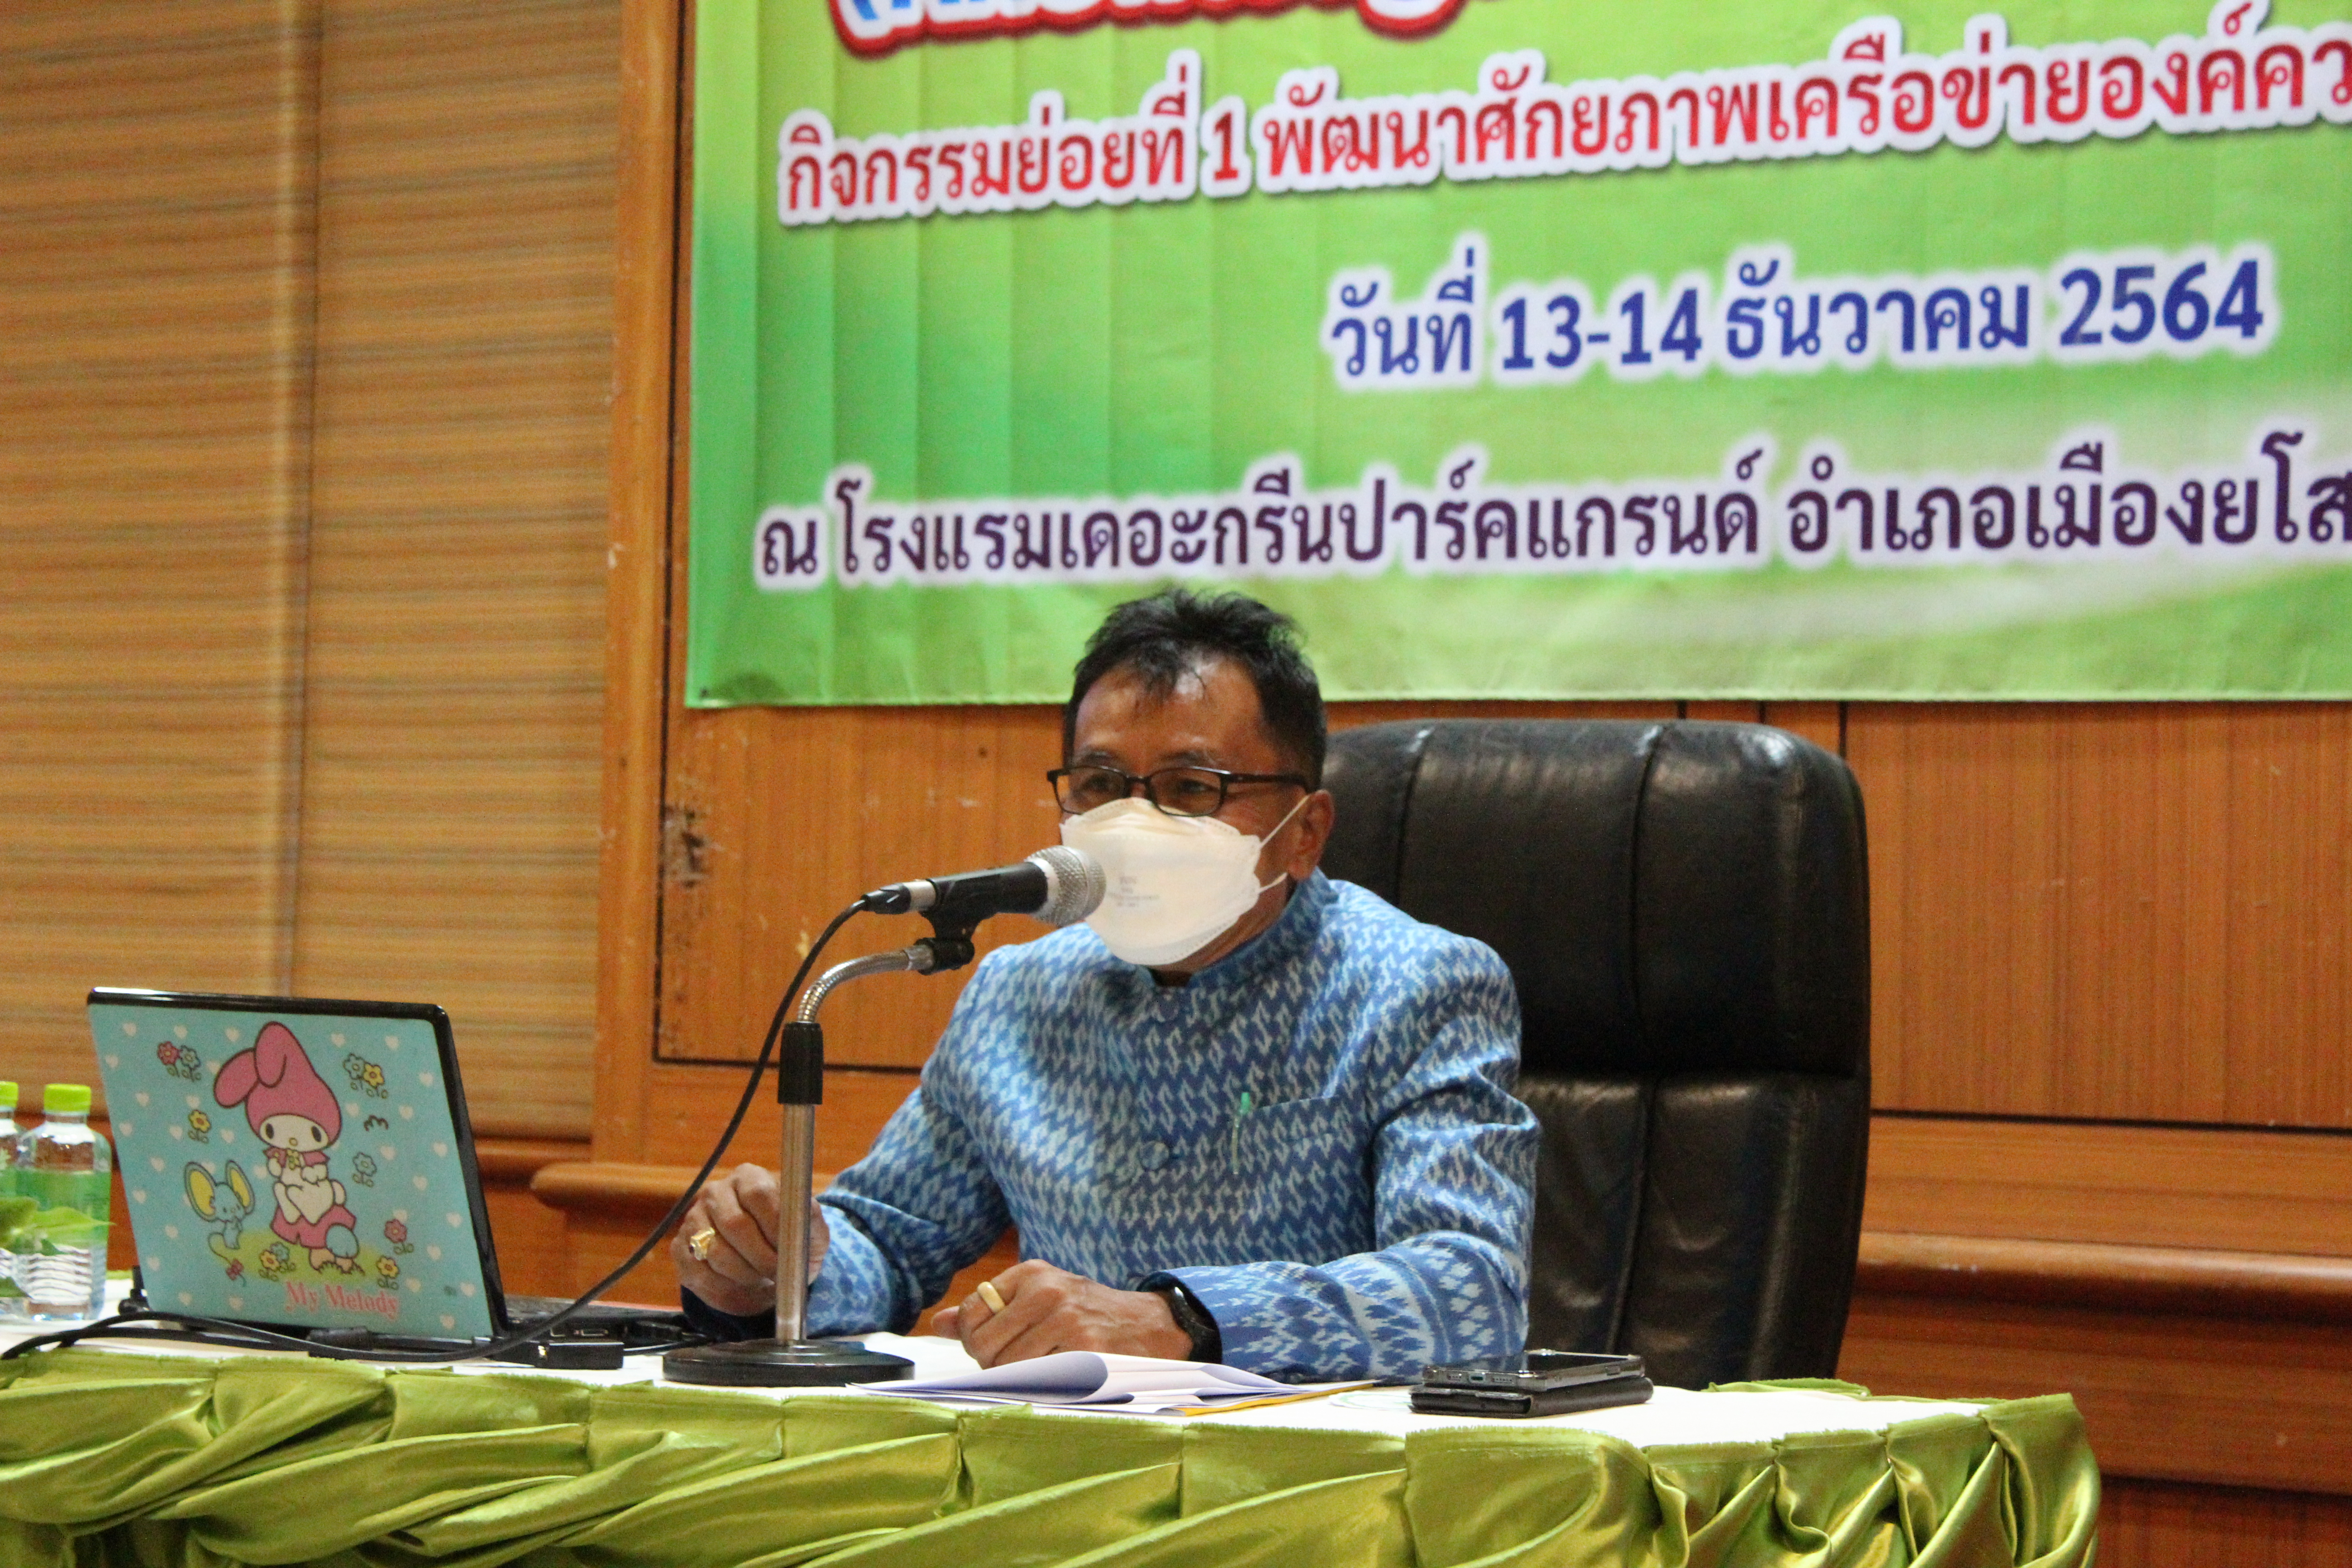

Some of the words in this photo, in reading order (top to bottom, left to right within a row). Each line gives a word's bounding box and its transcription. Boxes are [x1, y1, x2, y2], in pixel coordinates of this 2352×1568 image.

[788, 65, 1187, 210] กิจกรรมย่อยที่
[1213, 112, 1240, 182] 1
[1331, 247, 1475, 379] วันที่
[1501, 288, 1703, 372] 13-14
[1724, 259, 2030, 362] ธันวาคม
[2058, 259, 2264, 348] 2564
[763, 521, 817, 574] ณ
[836, 450, 1761, 573] โรงแรมเดอะกรีนปาร์คแกรนด์
[285, 1280, 318, 1312] My
[324, 1283, 398, 1319] Melody
